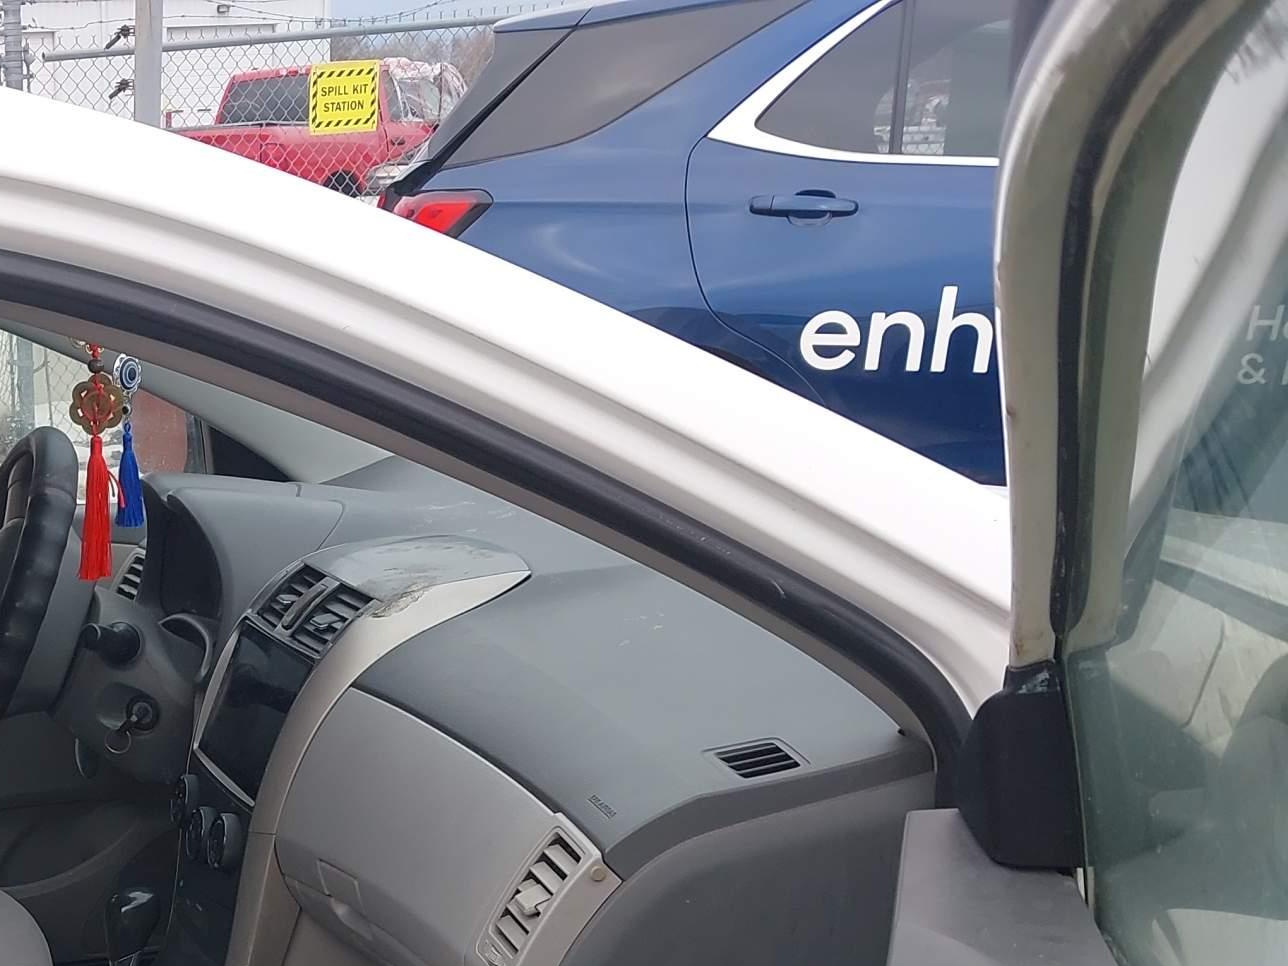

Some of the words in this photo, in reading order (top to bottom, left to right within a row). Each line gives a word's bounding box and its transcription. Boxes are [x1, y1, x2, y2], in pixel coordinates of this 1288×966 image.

[321, 85, 349, 96] SPILL
[353, 84, 368, 94] KIT
[323, 100, 364, 112] STATION
[800, 285, 993, 373] enh
[1246, 304, 1288, 340] H
[1238, 353, 1266, 384] &
